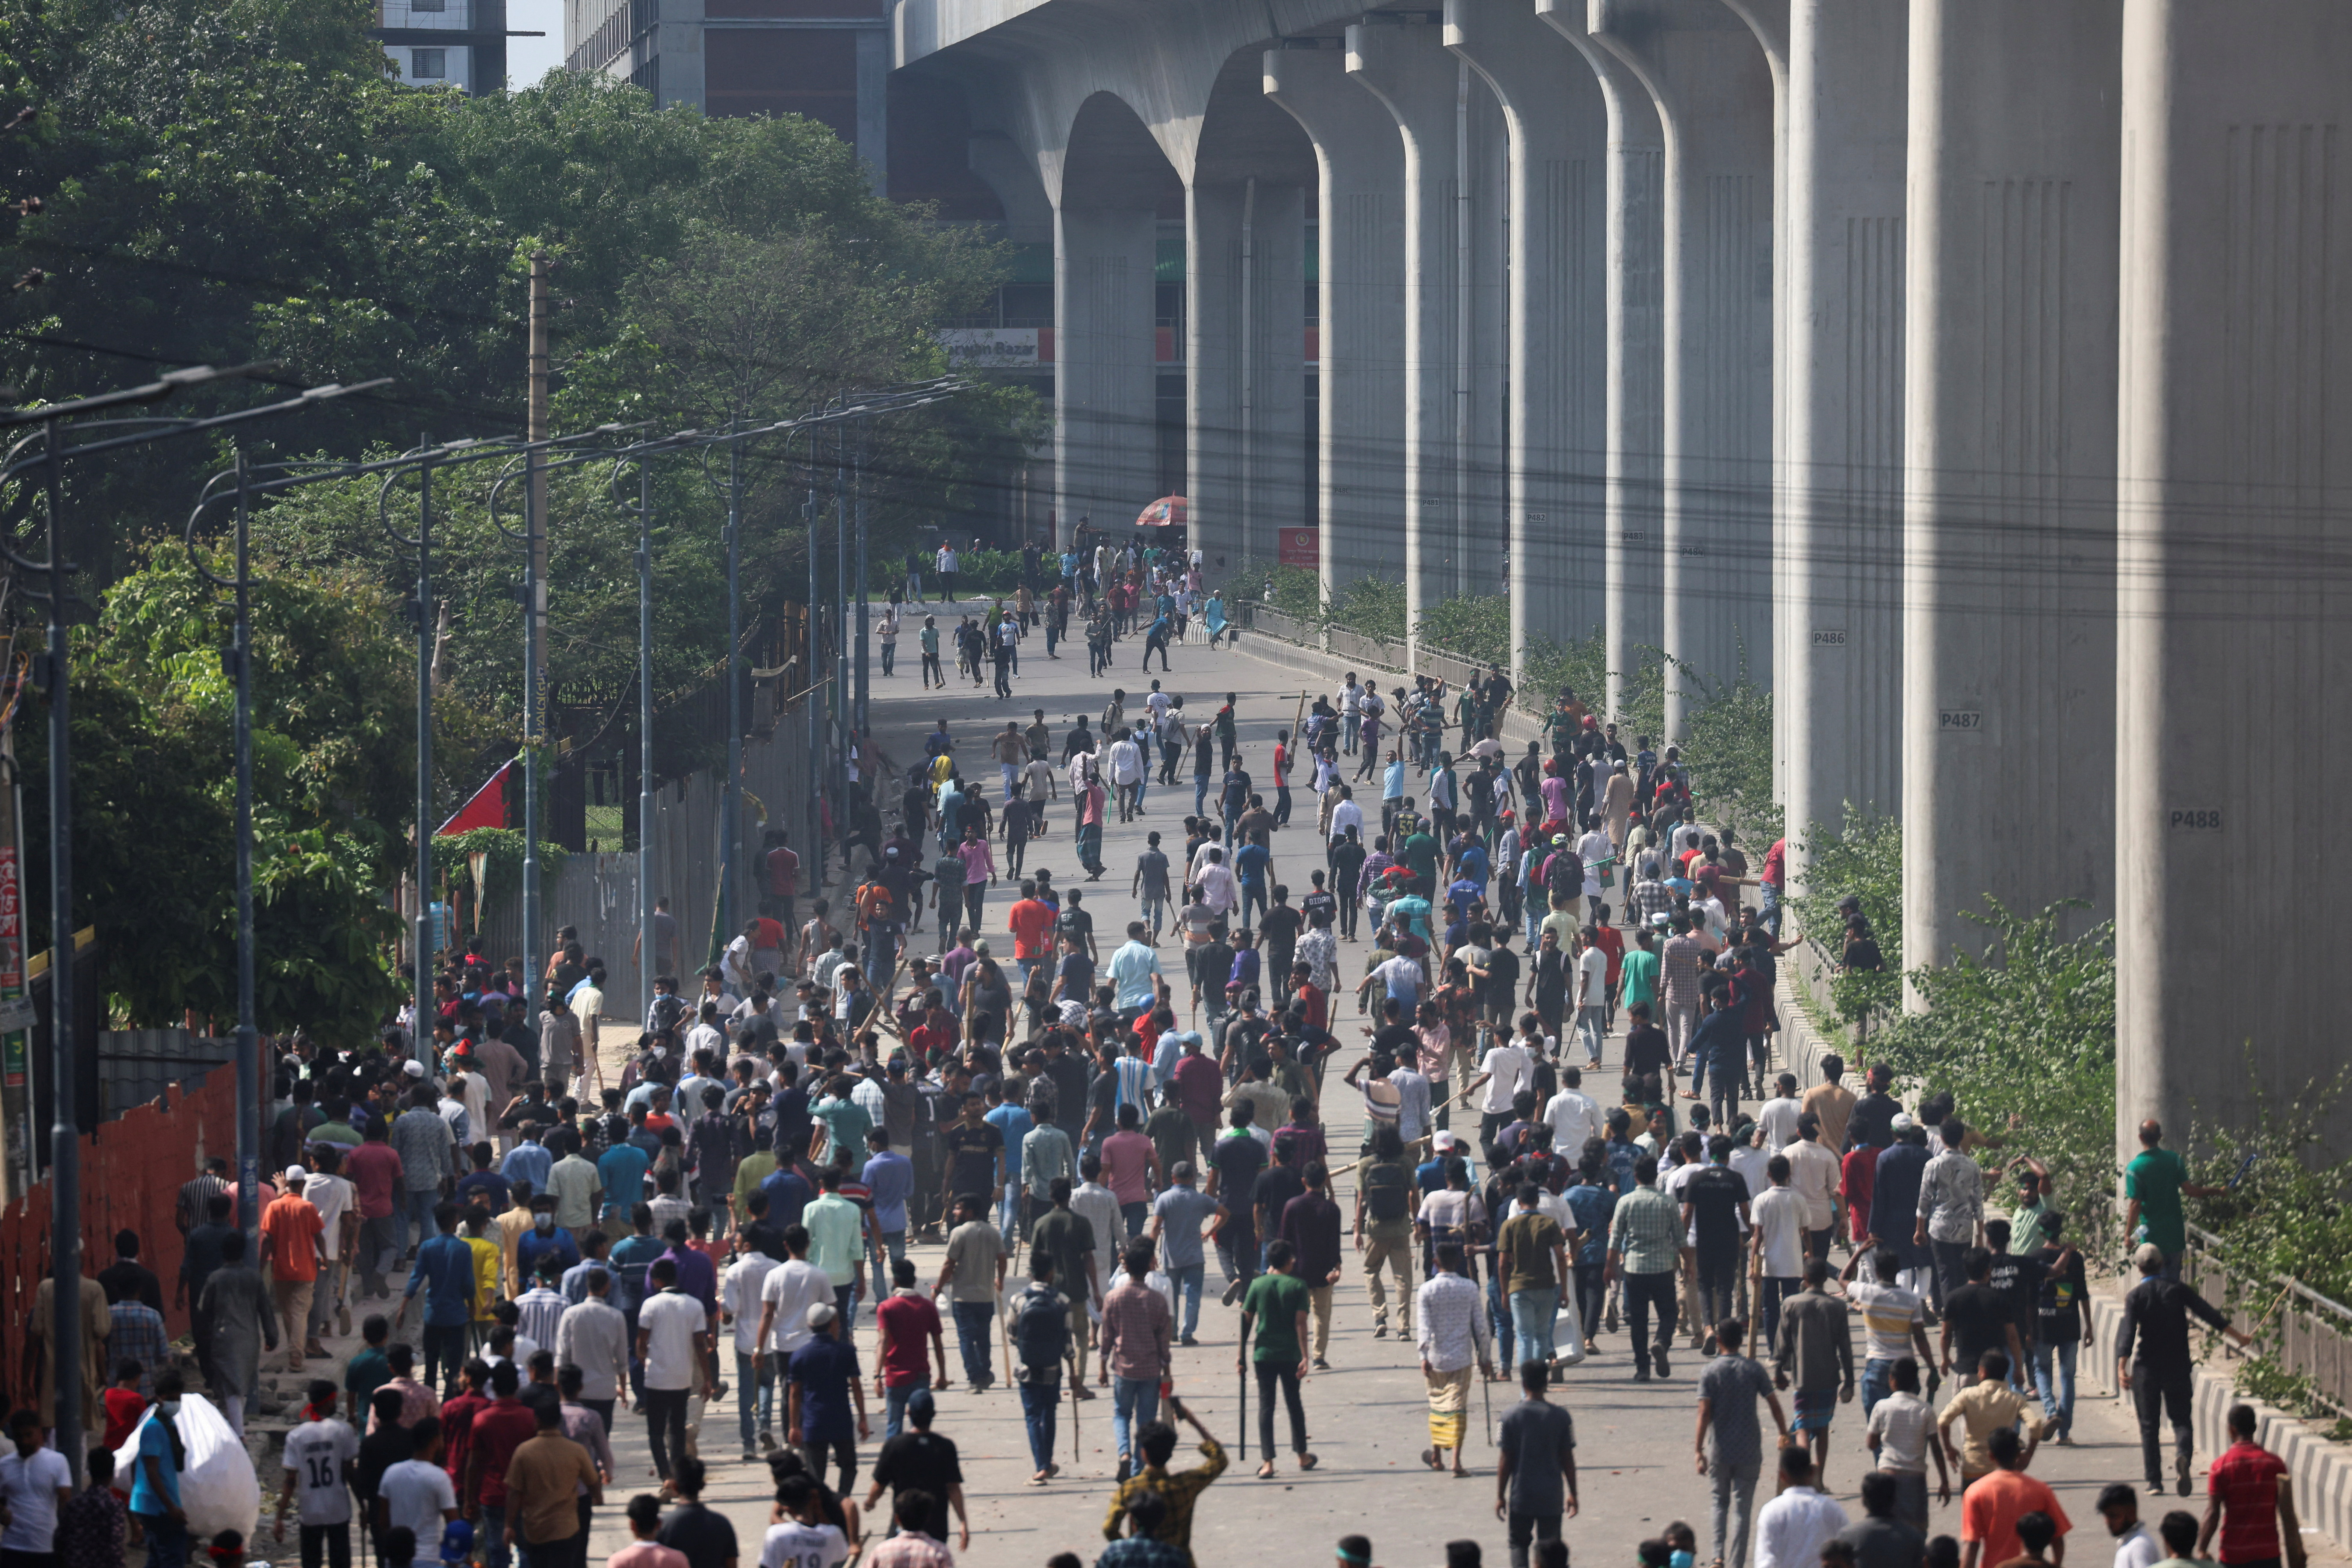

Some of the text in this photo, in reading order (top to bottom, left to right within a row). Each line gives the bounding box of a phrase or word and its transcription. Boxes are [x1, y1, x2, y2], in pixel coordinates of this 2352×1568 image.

[996, 342, 1035, 355] Bazar
[1682, 548, 1703, 556] P484
[1814, 633, 1845, 644] P486
[1942, 713, 1980, 727] P487
[2171, 811, 2220, 828] P488
[1399, 820, 1414, 836] 53
[1309, 895, 1331, 905] DIDAR
[2038, 1307, 2056, 1316] YOUR
[307, 1456, 334, 1488] 16
